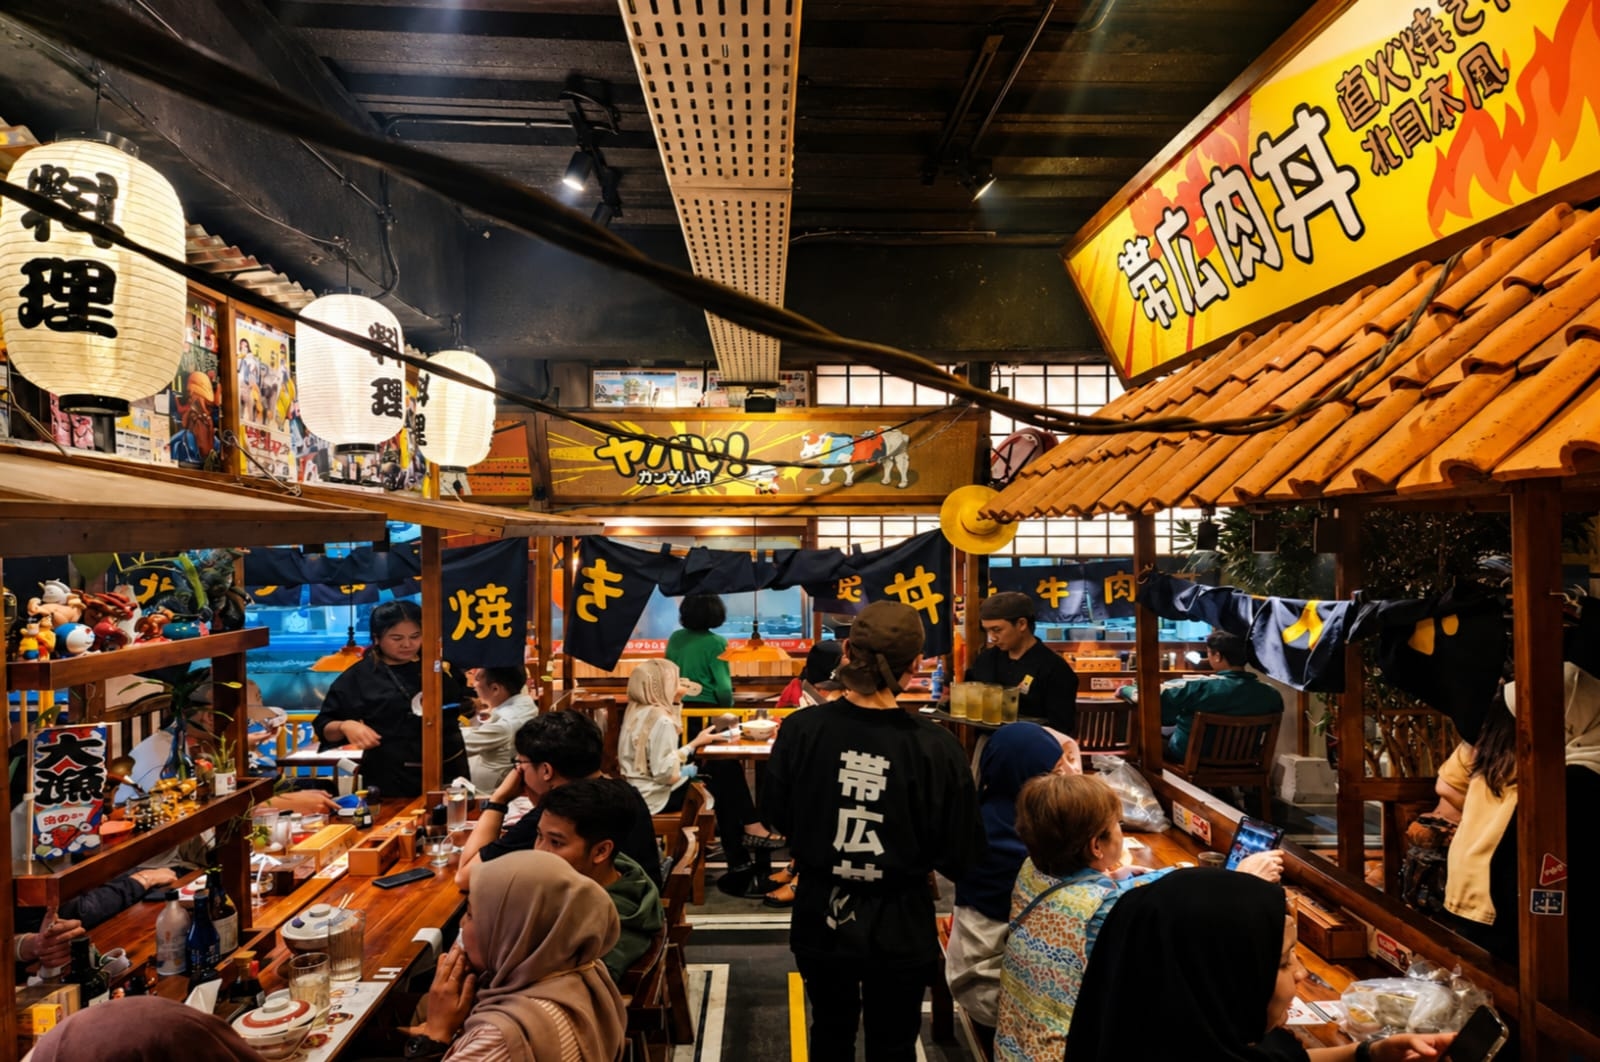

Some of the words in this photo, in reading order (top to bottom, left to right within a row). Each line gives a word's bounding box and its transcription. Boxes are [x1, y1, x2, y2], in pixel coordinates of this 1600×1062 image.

[1336, 0, 1510, 131] 直火焼き
[1117, 103, 1366, 327] 帯広肉丼
[449, 583, 513, 641] 焼
[575, 558, 624, 623] き
[34, 733, 105, 806] 大漁
